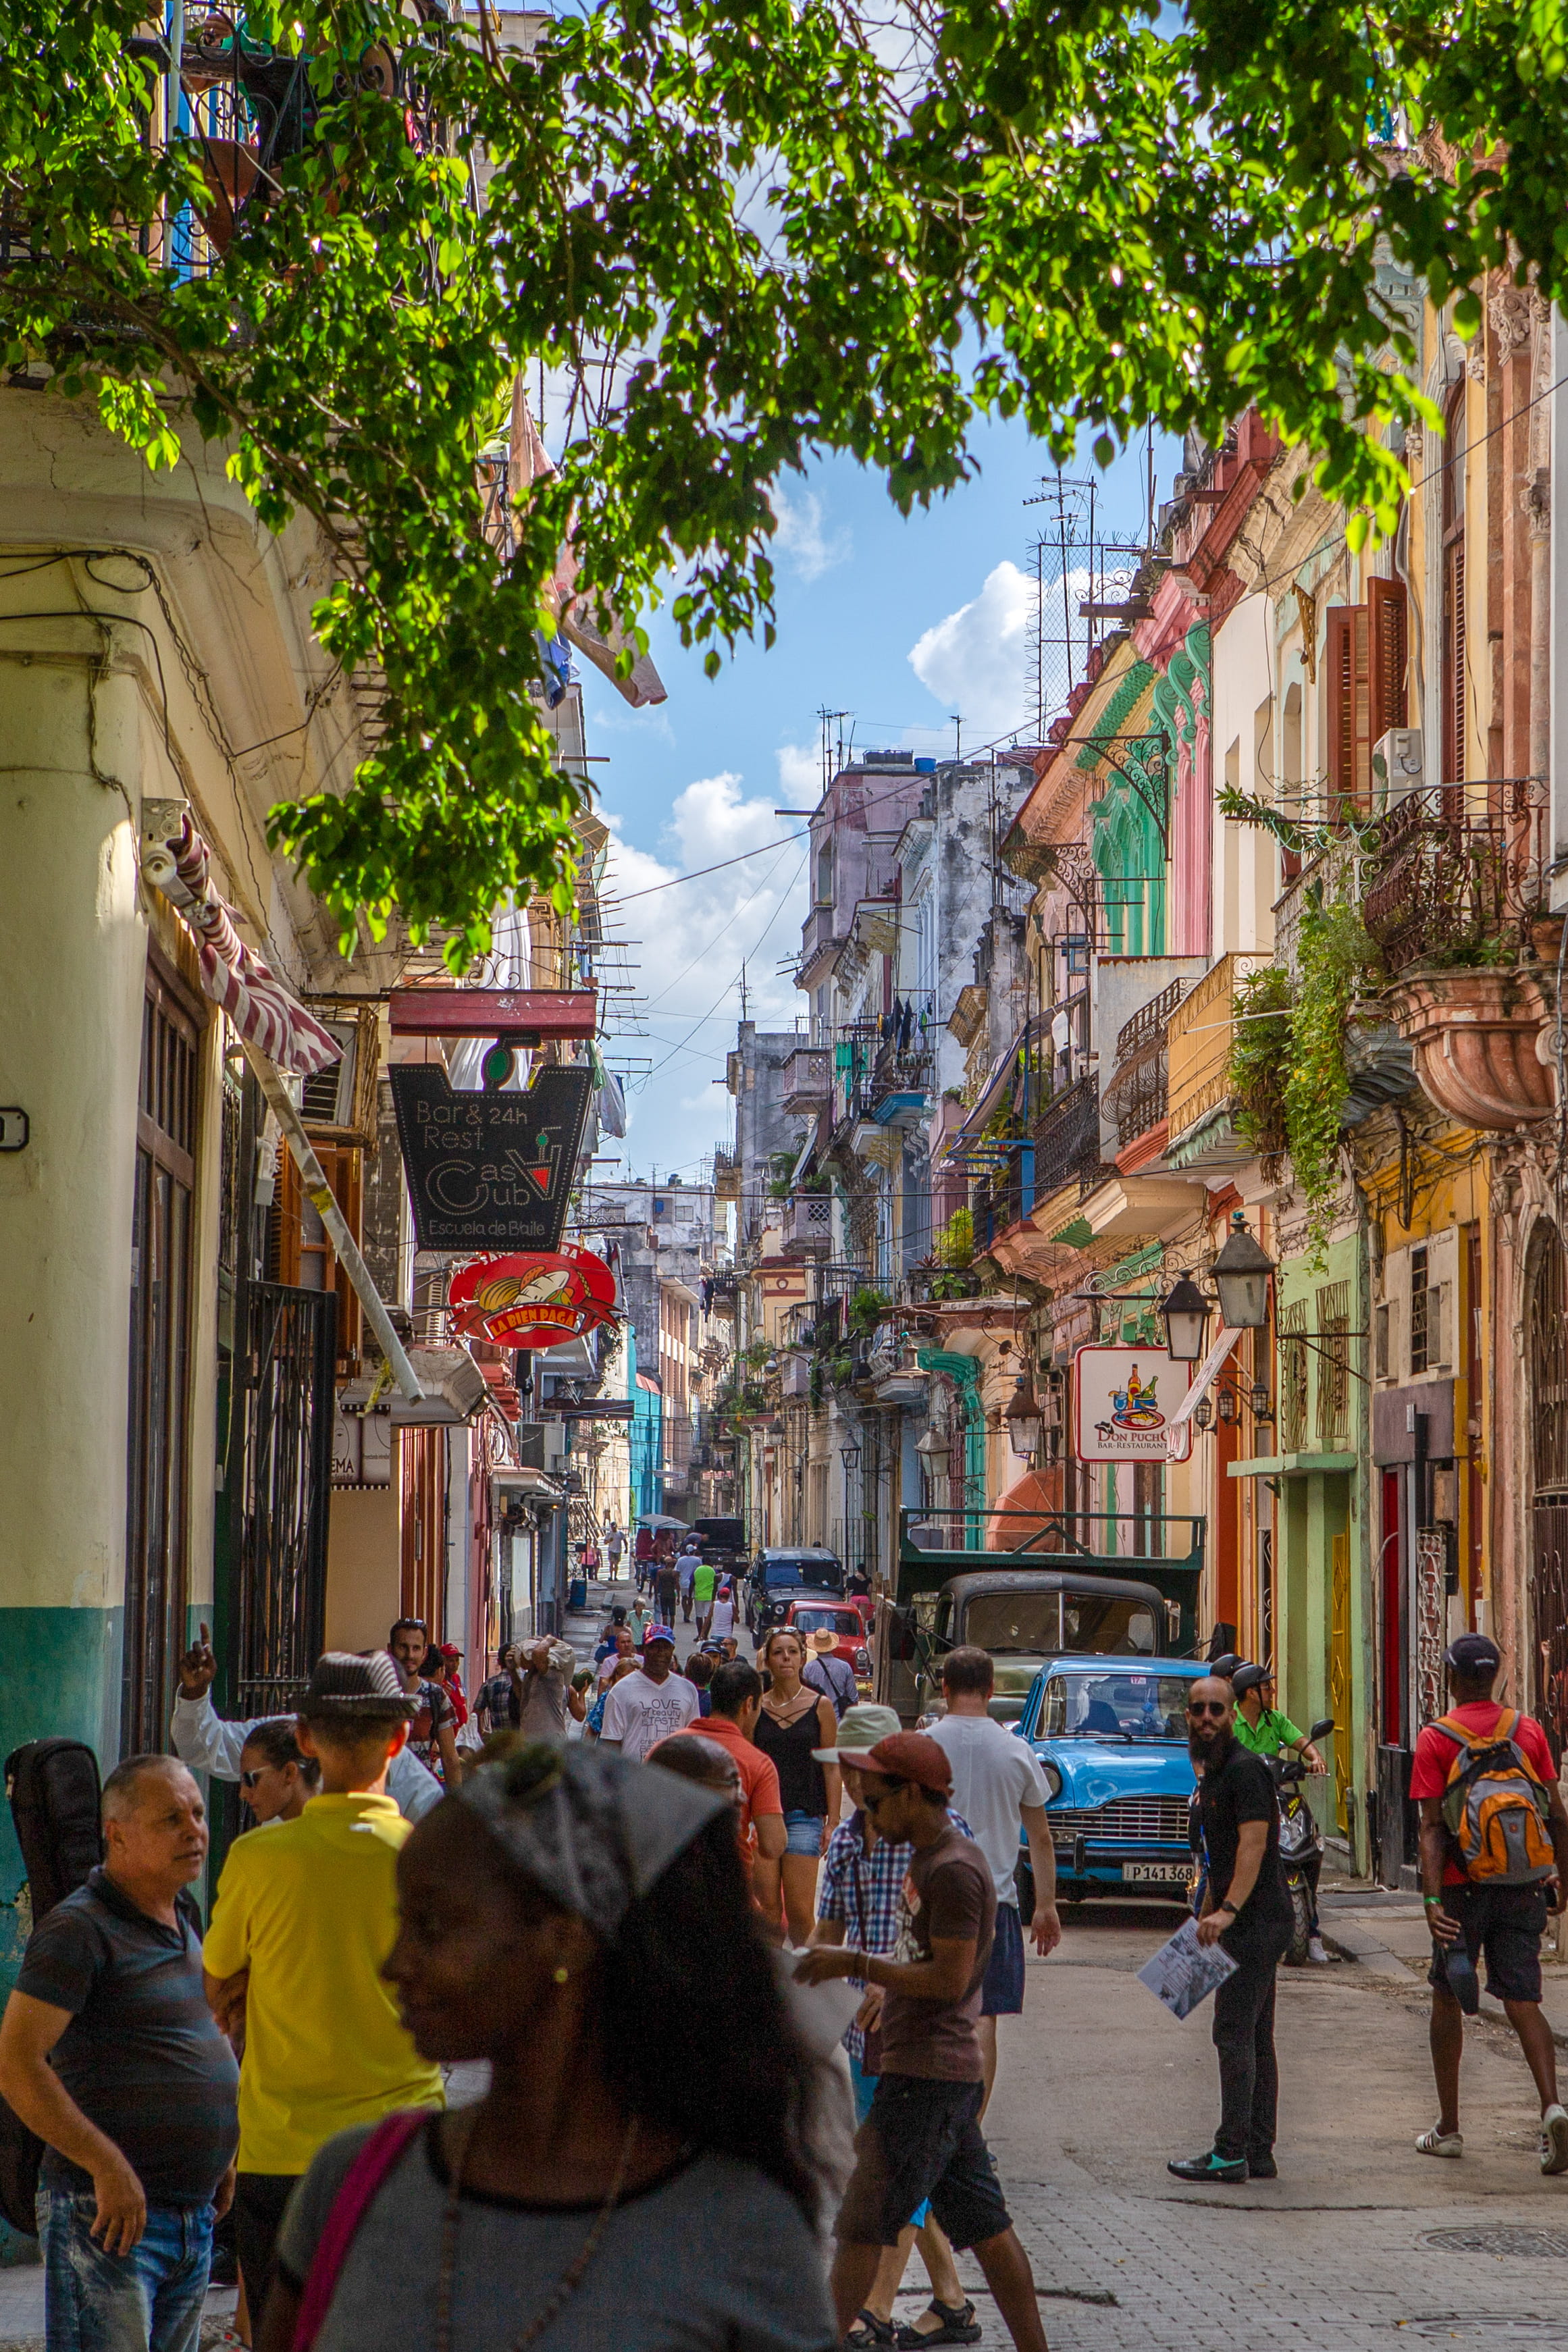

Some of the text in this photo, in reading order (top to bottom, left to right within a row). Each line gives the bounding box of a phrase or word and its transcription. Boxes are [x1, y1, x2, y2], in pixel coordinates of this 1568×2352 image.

[417, 1100, 528, 1124] Bar & 24h
[429, 1220, 546, 1236] Escuela de Baile
[489, 1307, 575, 1337] LA BIEN PAGÁ
[331, 1457, 355, 1473] EMA
[639, 1698, 681, 1710] LOVE
